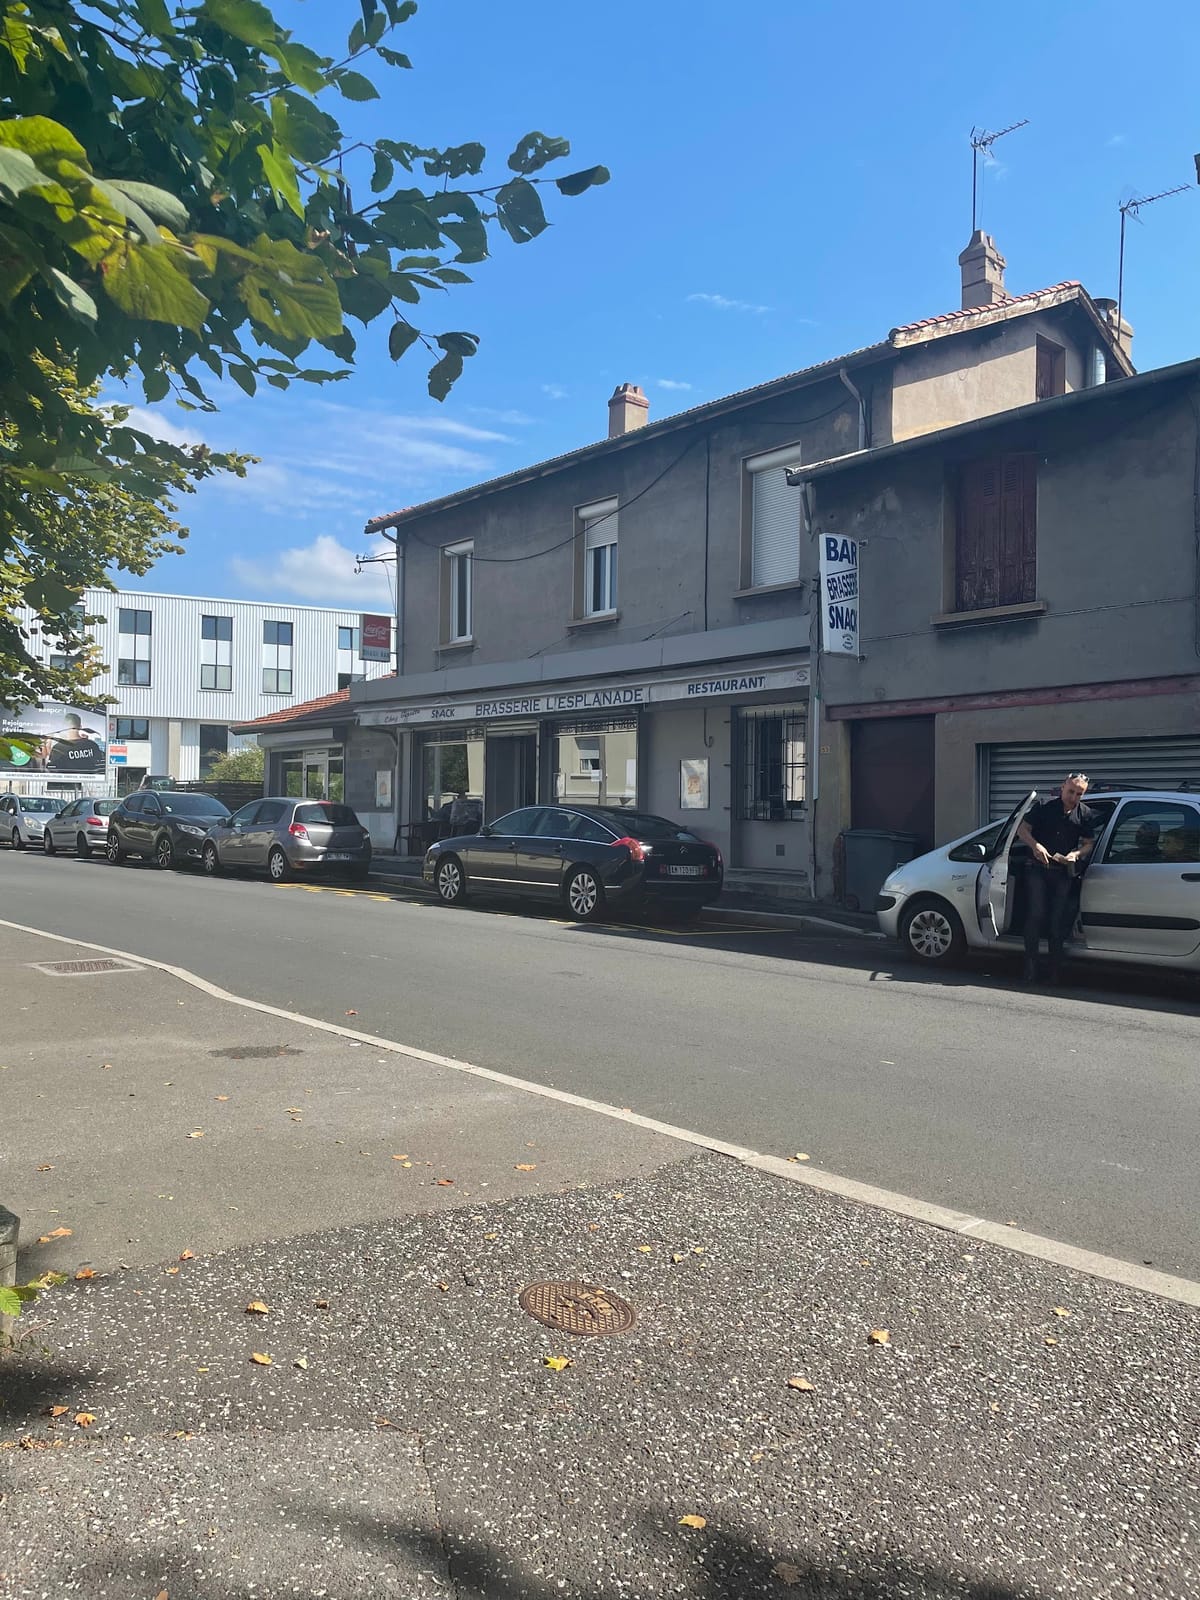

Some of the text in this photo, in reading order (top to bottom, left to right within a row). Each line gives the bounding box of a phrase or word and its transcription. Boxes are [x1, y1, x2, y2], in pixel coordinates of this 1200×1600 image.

[825, 537, 857, 567] BAR
[687, 676, 766, 695] RESTAURANT
[475, 688, 644, 716] BRASSERIE L'ESPLANADE
[68, 748, 94, 760] COACH
